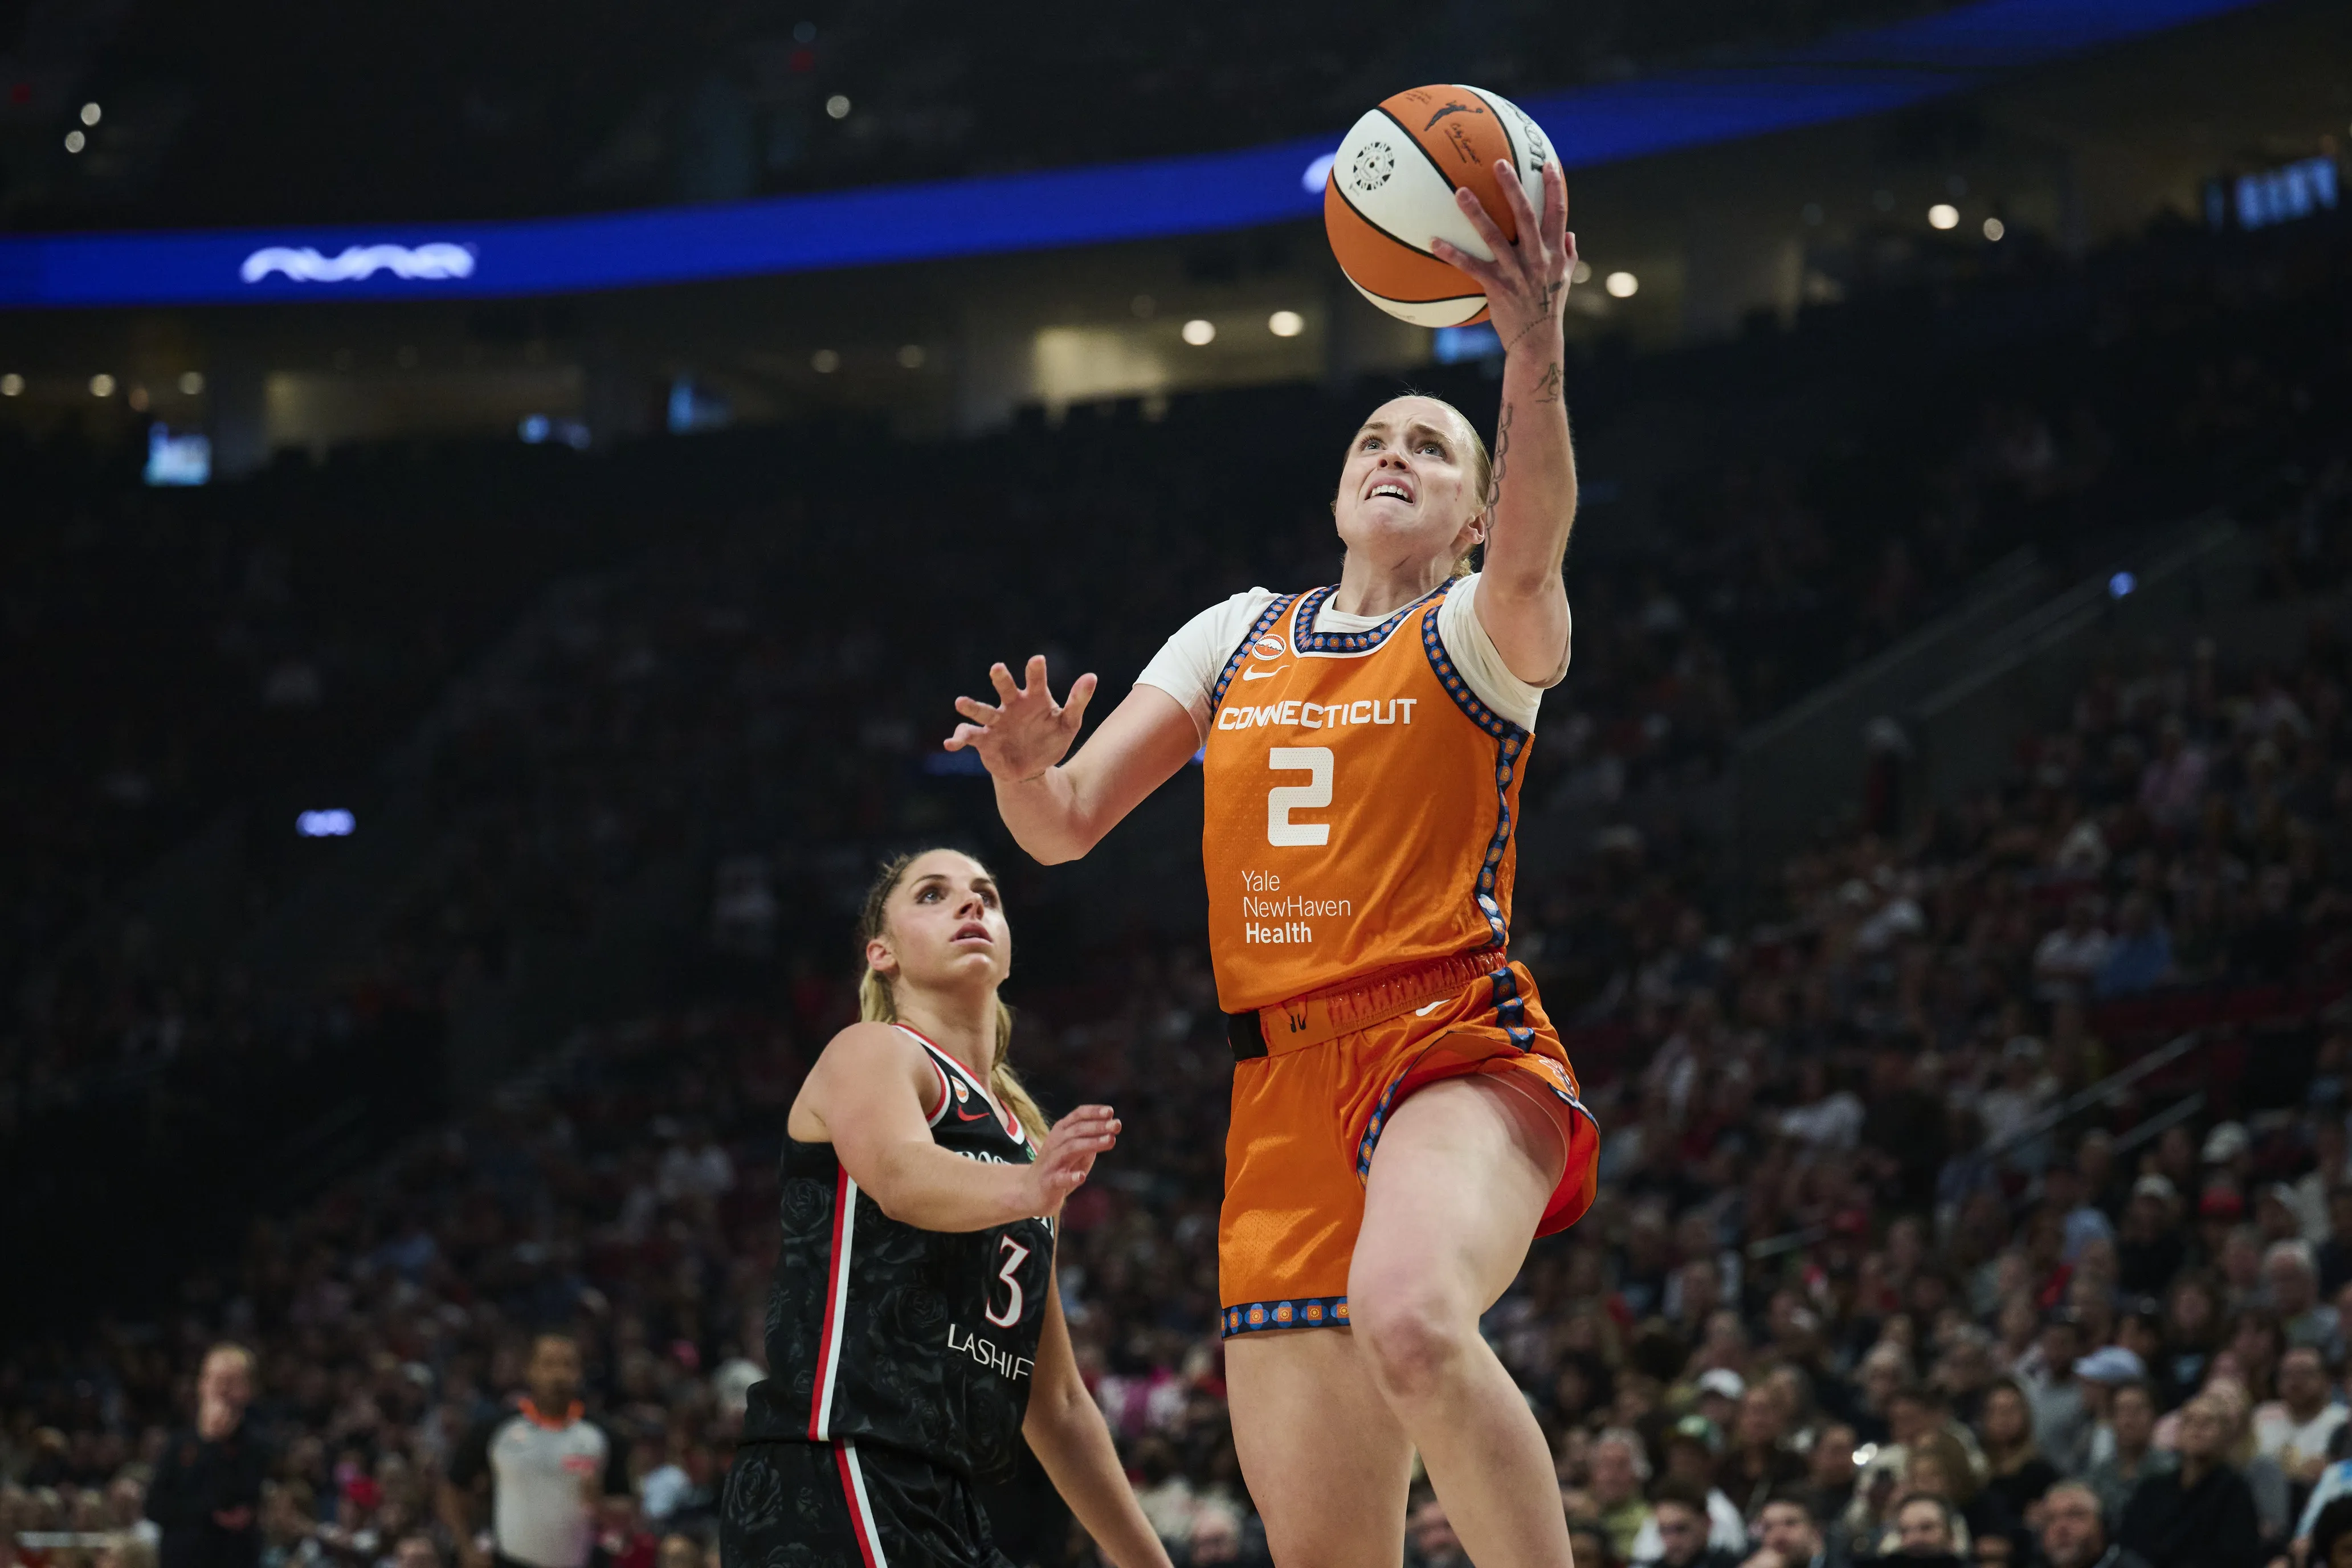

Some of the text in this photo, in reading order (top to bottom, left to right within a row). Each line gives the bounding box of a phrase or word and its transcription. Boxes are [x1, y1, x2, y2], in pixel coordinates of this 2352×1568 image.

[1218, 699, 1417, 730] CONNECTICUT
[1268, 747, 1334, 847] 2
[1242, 871, 1280, 892] Yale
[1244, 896, 1350, 917] NewHaven
[1246, 922, 1312, 944] Health
[985, 1235, 1030, 1328] 3
[948, 1324, 1035, 1380] LASHIF
